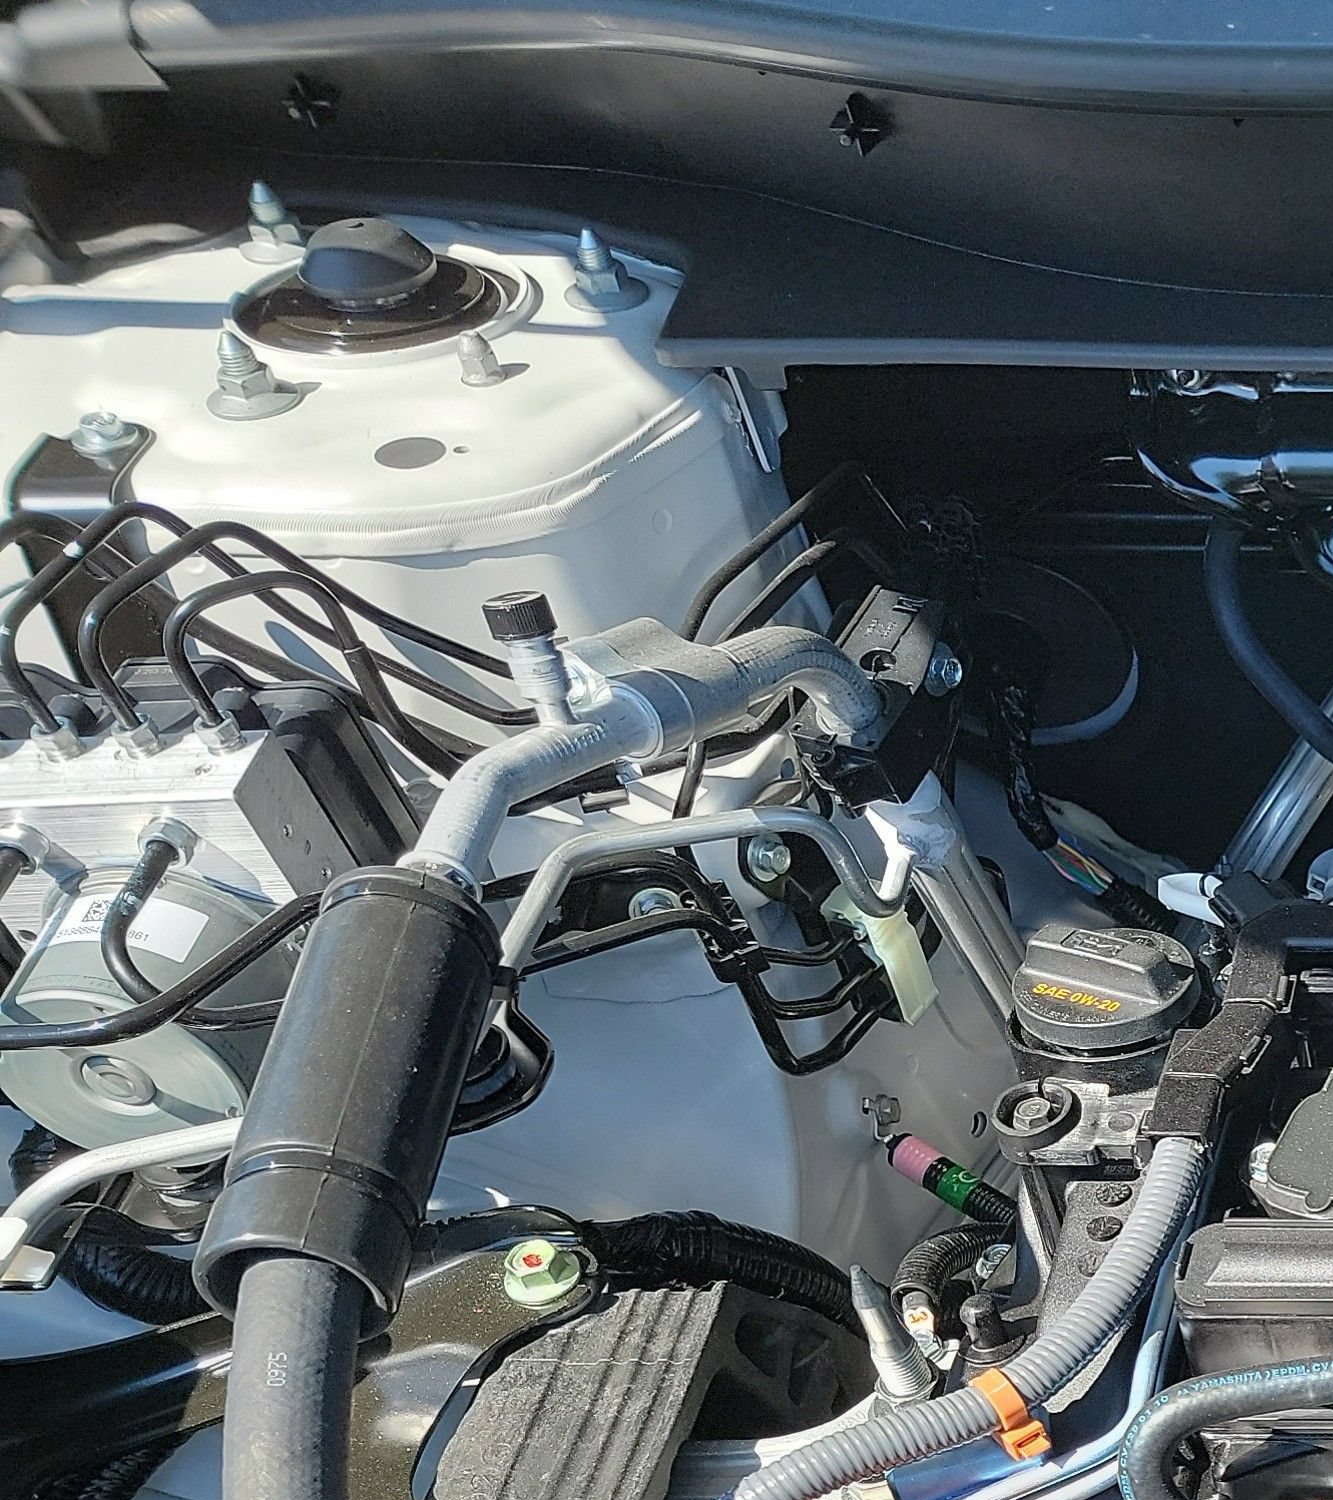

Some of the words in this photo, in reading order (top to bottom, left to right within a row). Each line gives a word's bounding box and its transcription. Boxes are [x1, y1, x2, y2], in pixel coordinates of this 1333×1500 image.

[1032, 983, 1071, 1000] SAE
[1069, 991, 1121, 1013] 0W-20
[266, 1351, 289, 1388] 0975
[1191, 1371, 1263, 1393] YAMASHITA
[1312, 1361, 1329, 1373] CV
